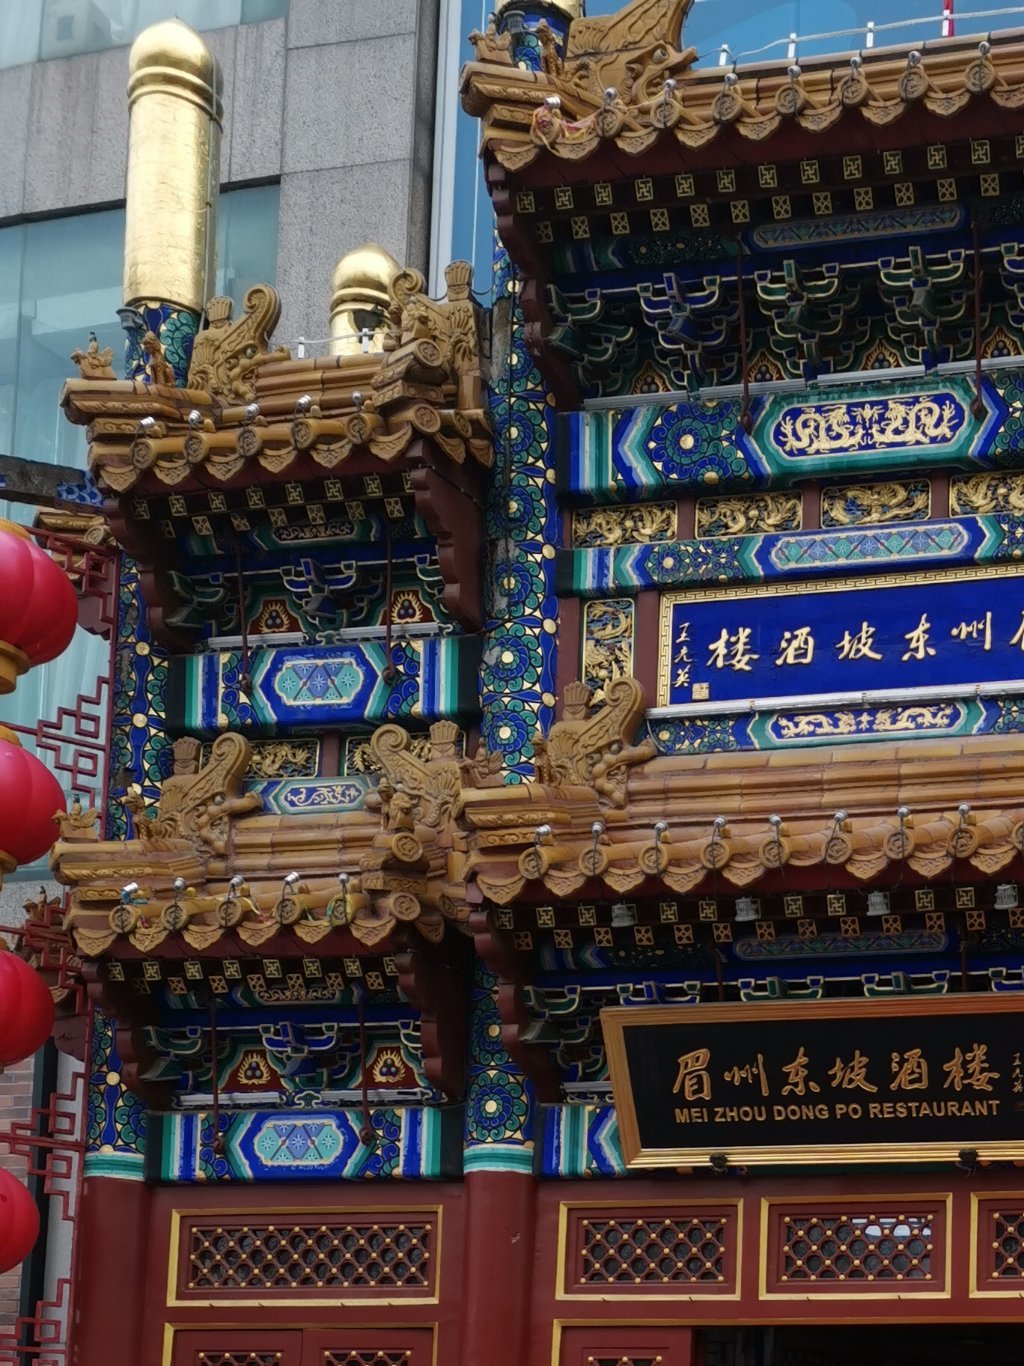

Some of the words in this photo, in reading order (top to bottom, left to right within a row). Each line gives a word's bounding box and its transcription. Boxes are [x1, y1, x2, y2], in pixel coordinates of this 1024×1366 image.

[672, 1043, 1000, 1101] 眉州东坡酒楼
[674, 1107, 708, 1123] MEI
[713, 1105, 767, 1122] ZHOU
[773, 1103, 829, 1120] DONG
[835, 1103, 862, 1119] PO
[868, 1099, 1000, 1119] RESTAURANT
